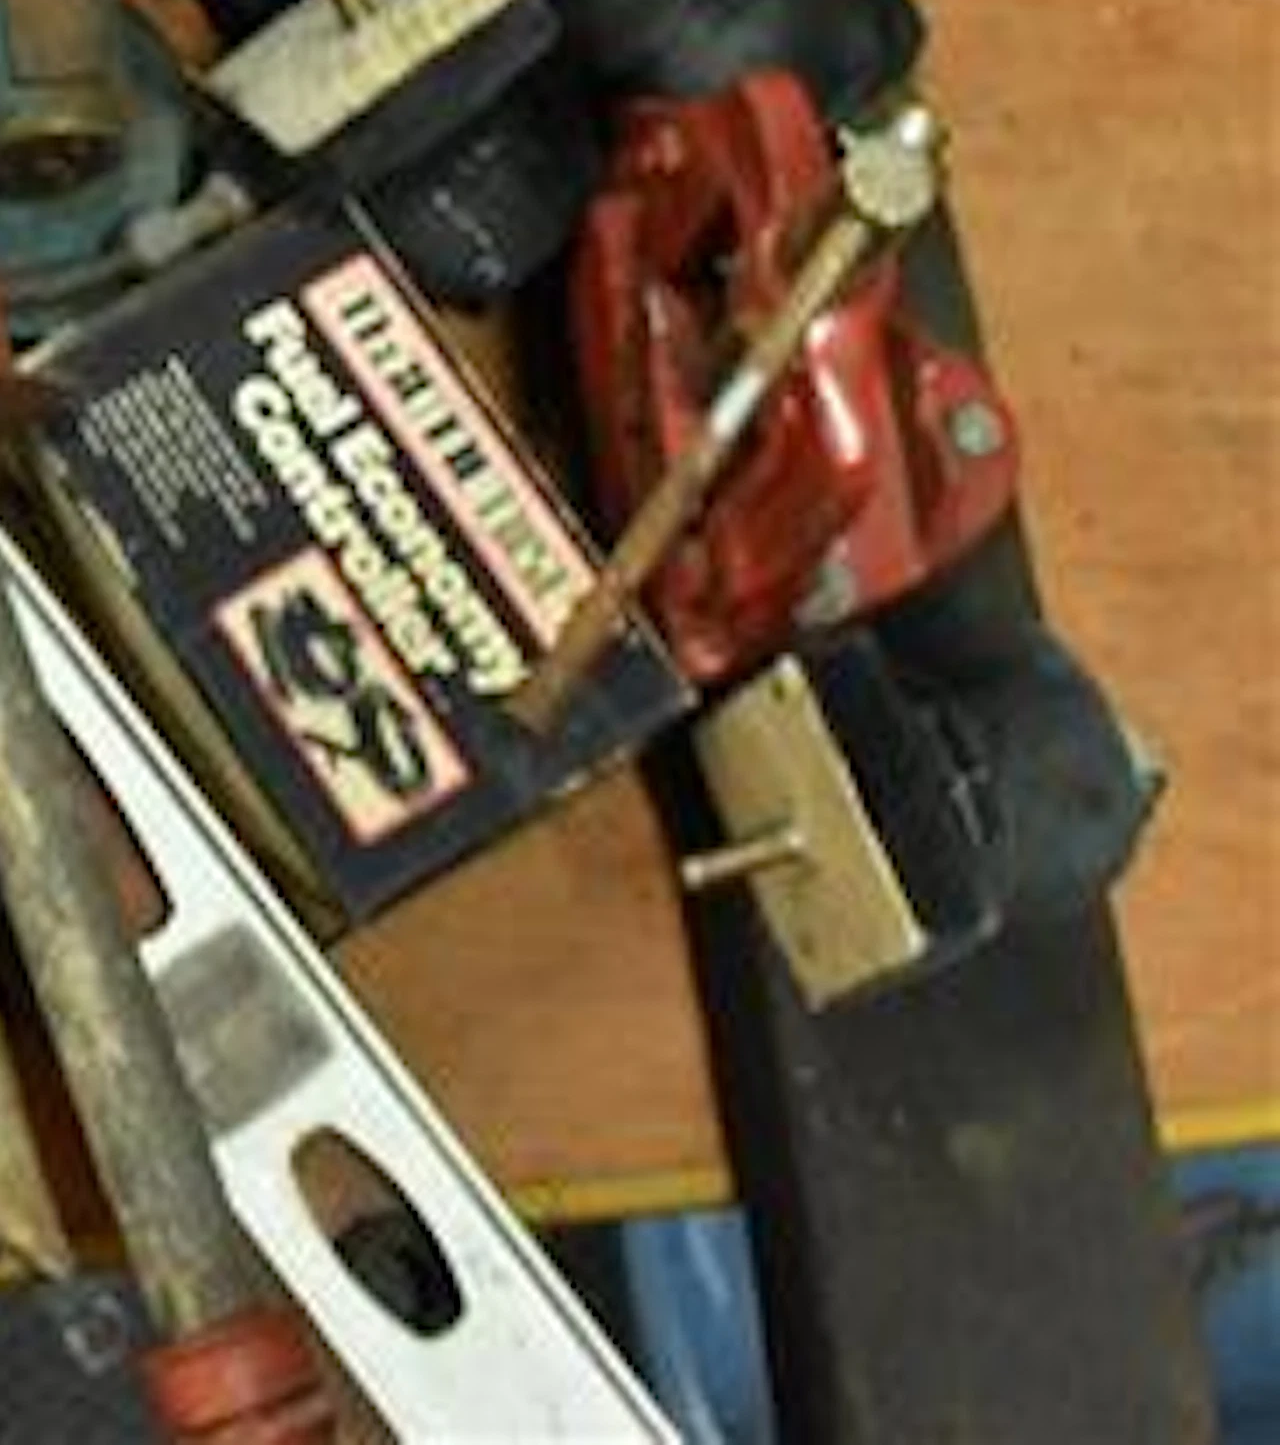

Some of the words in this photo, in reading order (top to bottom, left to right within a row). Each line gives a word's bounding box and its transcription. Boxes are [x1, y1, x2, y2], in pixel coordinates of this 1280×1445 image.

[230, 374, 459, 680] Controller
[240, 296, 364, 438] Fuel
[320, 418, 537, 699] Economy
